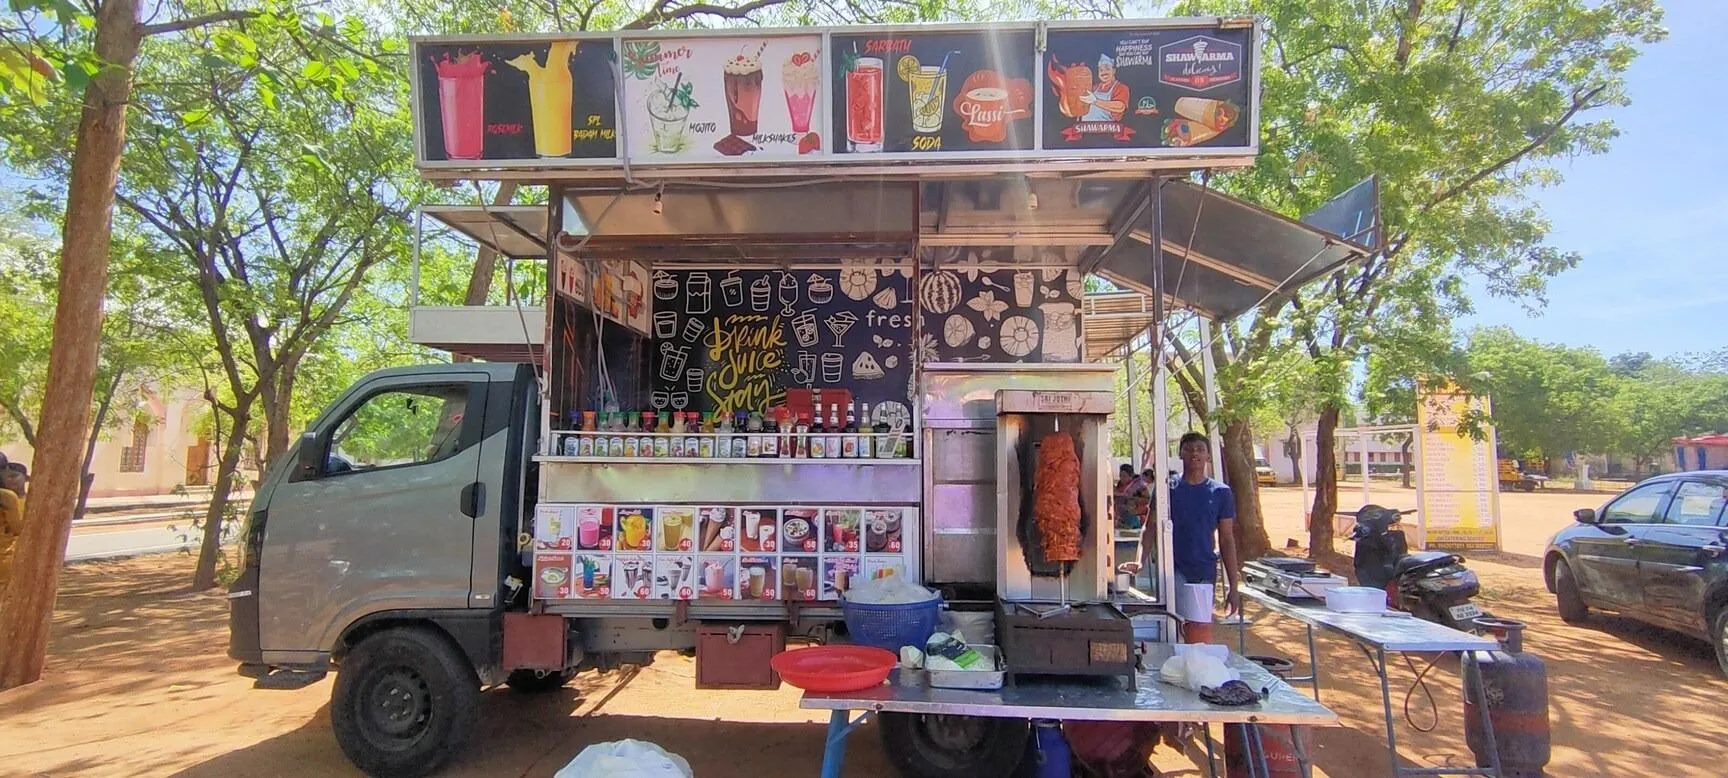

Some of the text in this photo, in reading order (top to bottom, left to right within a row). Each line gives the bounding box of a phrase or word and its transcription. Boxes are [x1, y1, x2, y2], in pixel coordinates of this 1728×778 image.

[865, 39, 912, 54] SARBATH
[1115, 55, 1153, 68] SHAWARMA
[1165, 51, 1234, 63] SHAWARMA
[960, 102, 1026, 127] Lassi
[689, 121, 716, 134] MOJITO
[1075, 123, 1121, 133] SHAWARMA
[752, 132, 796, 144] MILKSHAKES
[912, 135, 941, 151] SODA
